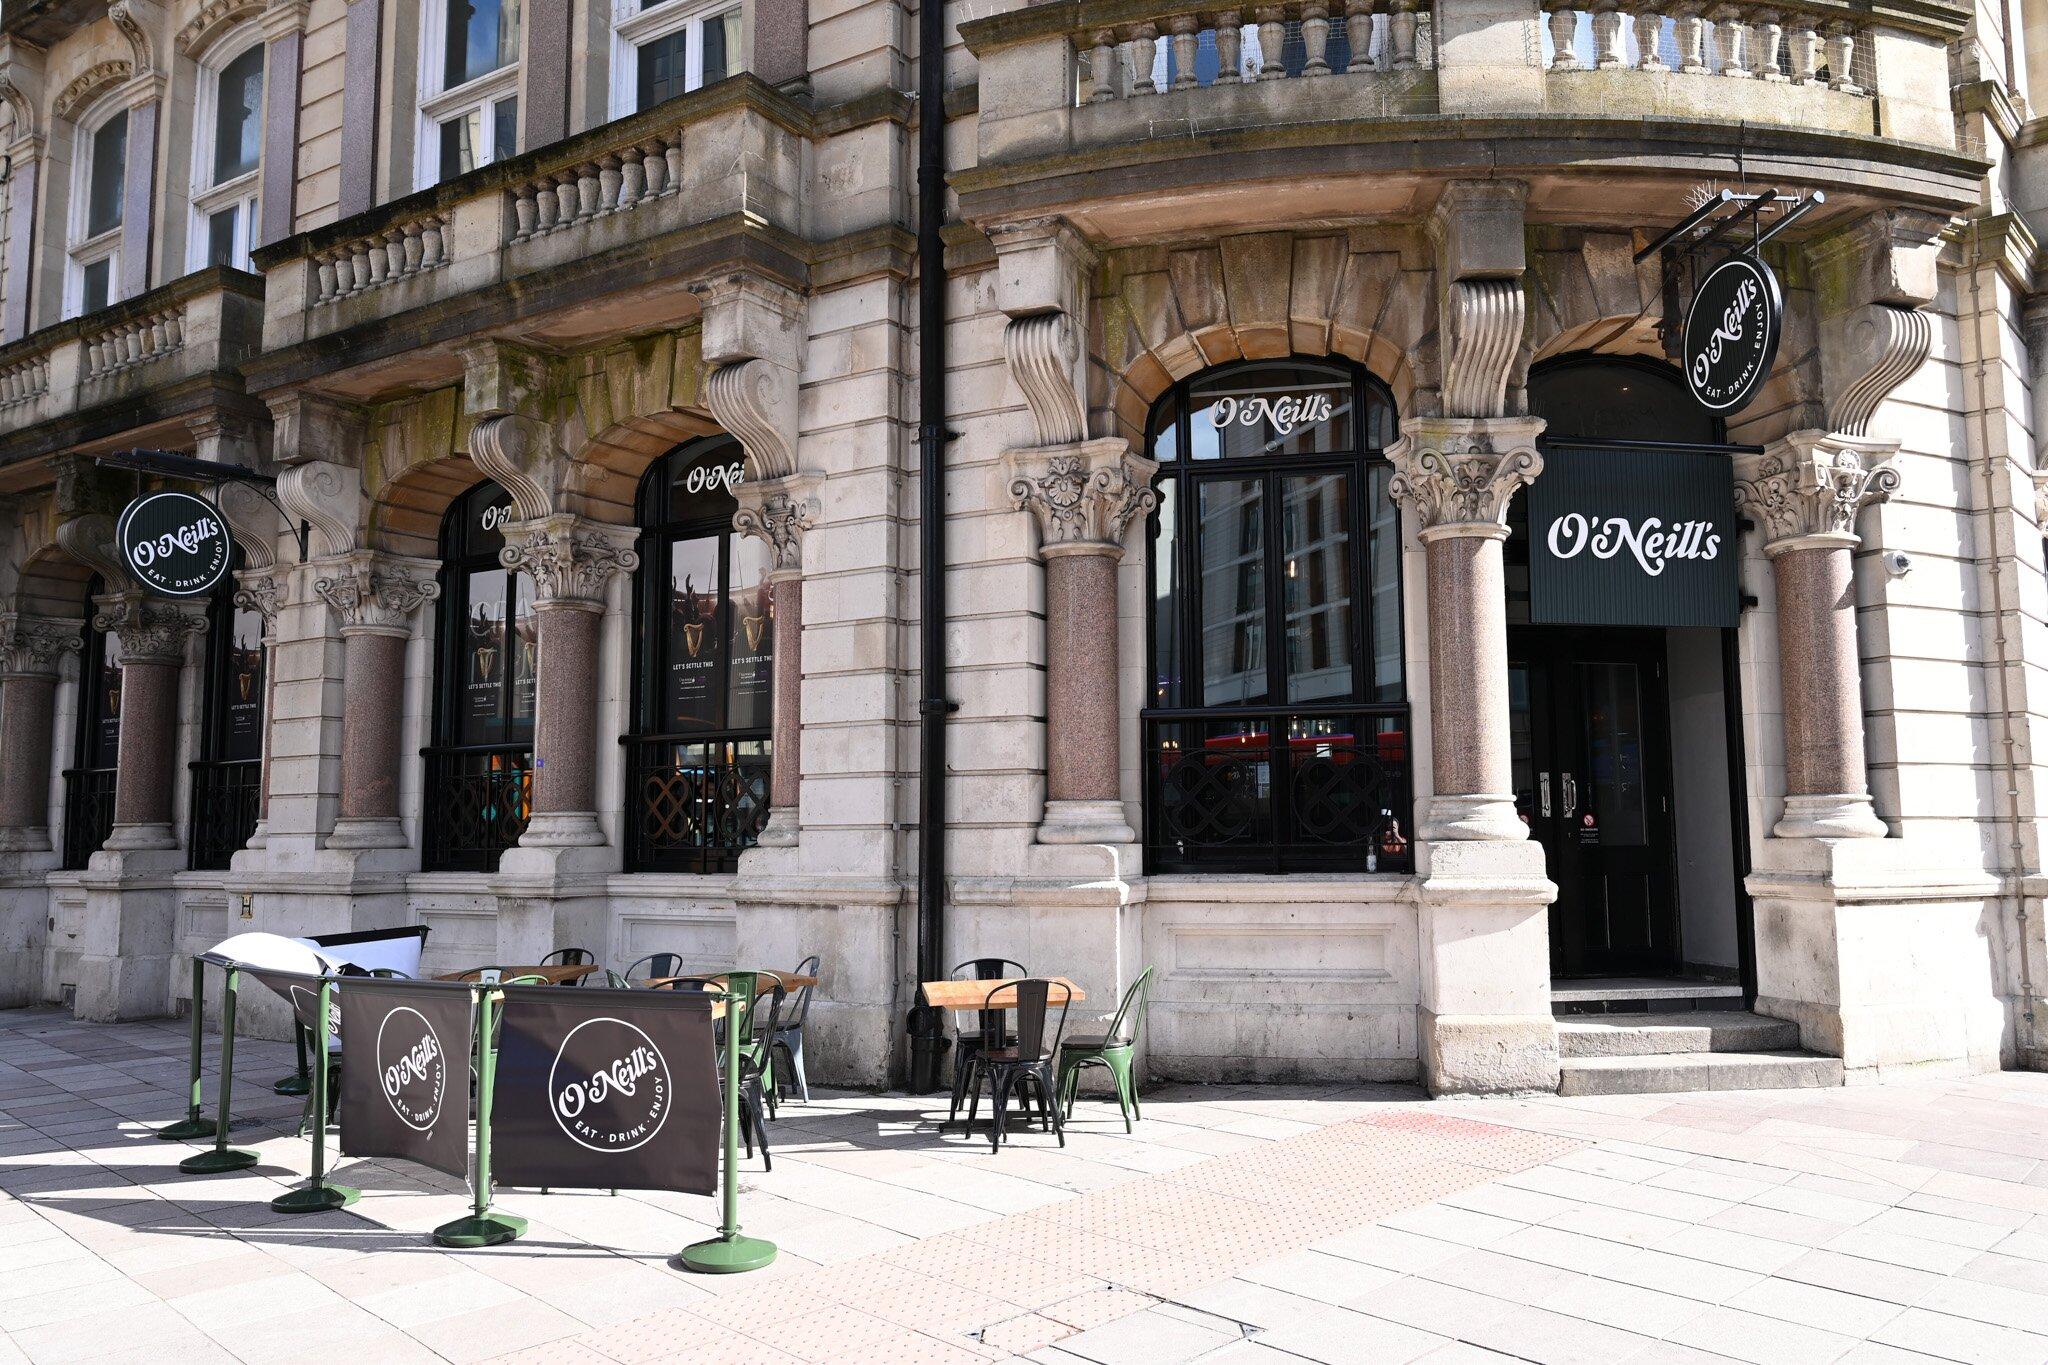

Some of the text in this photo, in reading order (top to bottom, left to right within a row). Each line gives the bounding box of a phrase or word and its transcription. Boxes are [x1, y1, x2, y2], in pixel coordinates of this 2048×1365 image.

[1693, 278, 1757, 388] O'Neill's
[1705, 303, 1764, 398] EAT DRINK ENJOY
[1208, 394, 1332, 435] O'Neill's
[686, 461, 744, 497] O'Nei
[133, 517, 219, 567] O'Neill's
[148, 540, 223, 587] EAT DRINK ENJOY
[1547, 512, 1721, 577] O'Neill's
[672, 660, 714, 671] LET'S SETTLE THIS
[732, 654, 772, 665] LET'S SETTLE THI
[385, 1033, 438, 1096] O'Neill's
[558, 1045, 657, 1118] O'Neill's
[397, 1098, 410, 1116] EAT
[414, 1105, 434, 1122] DRINK
[574, 1076, 663, 1143] EAT DRINK ENJOY
